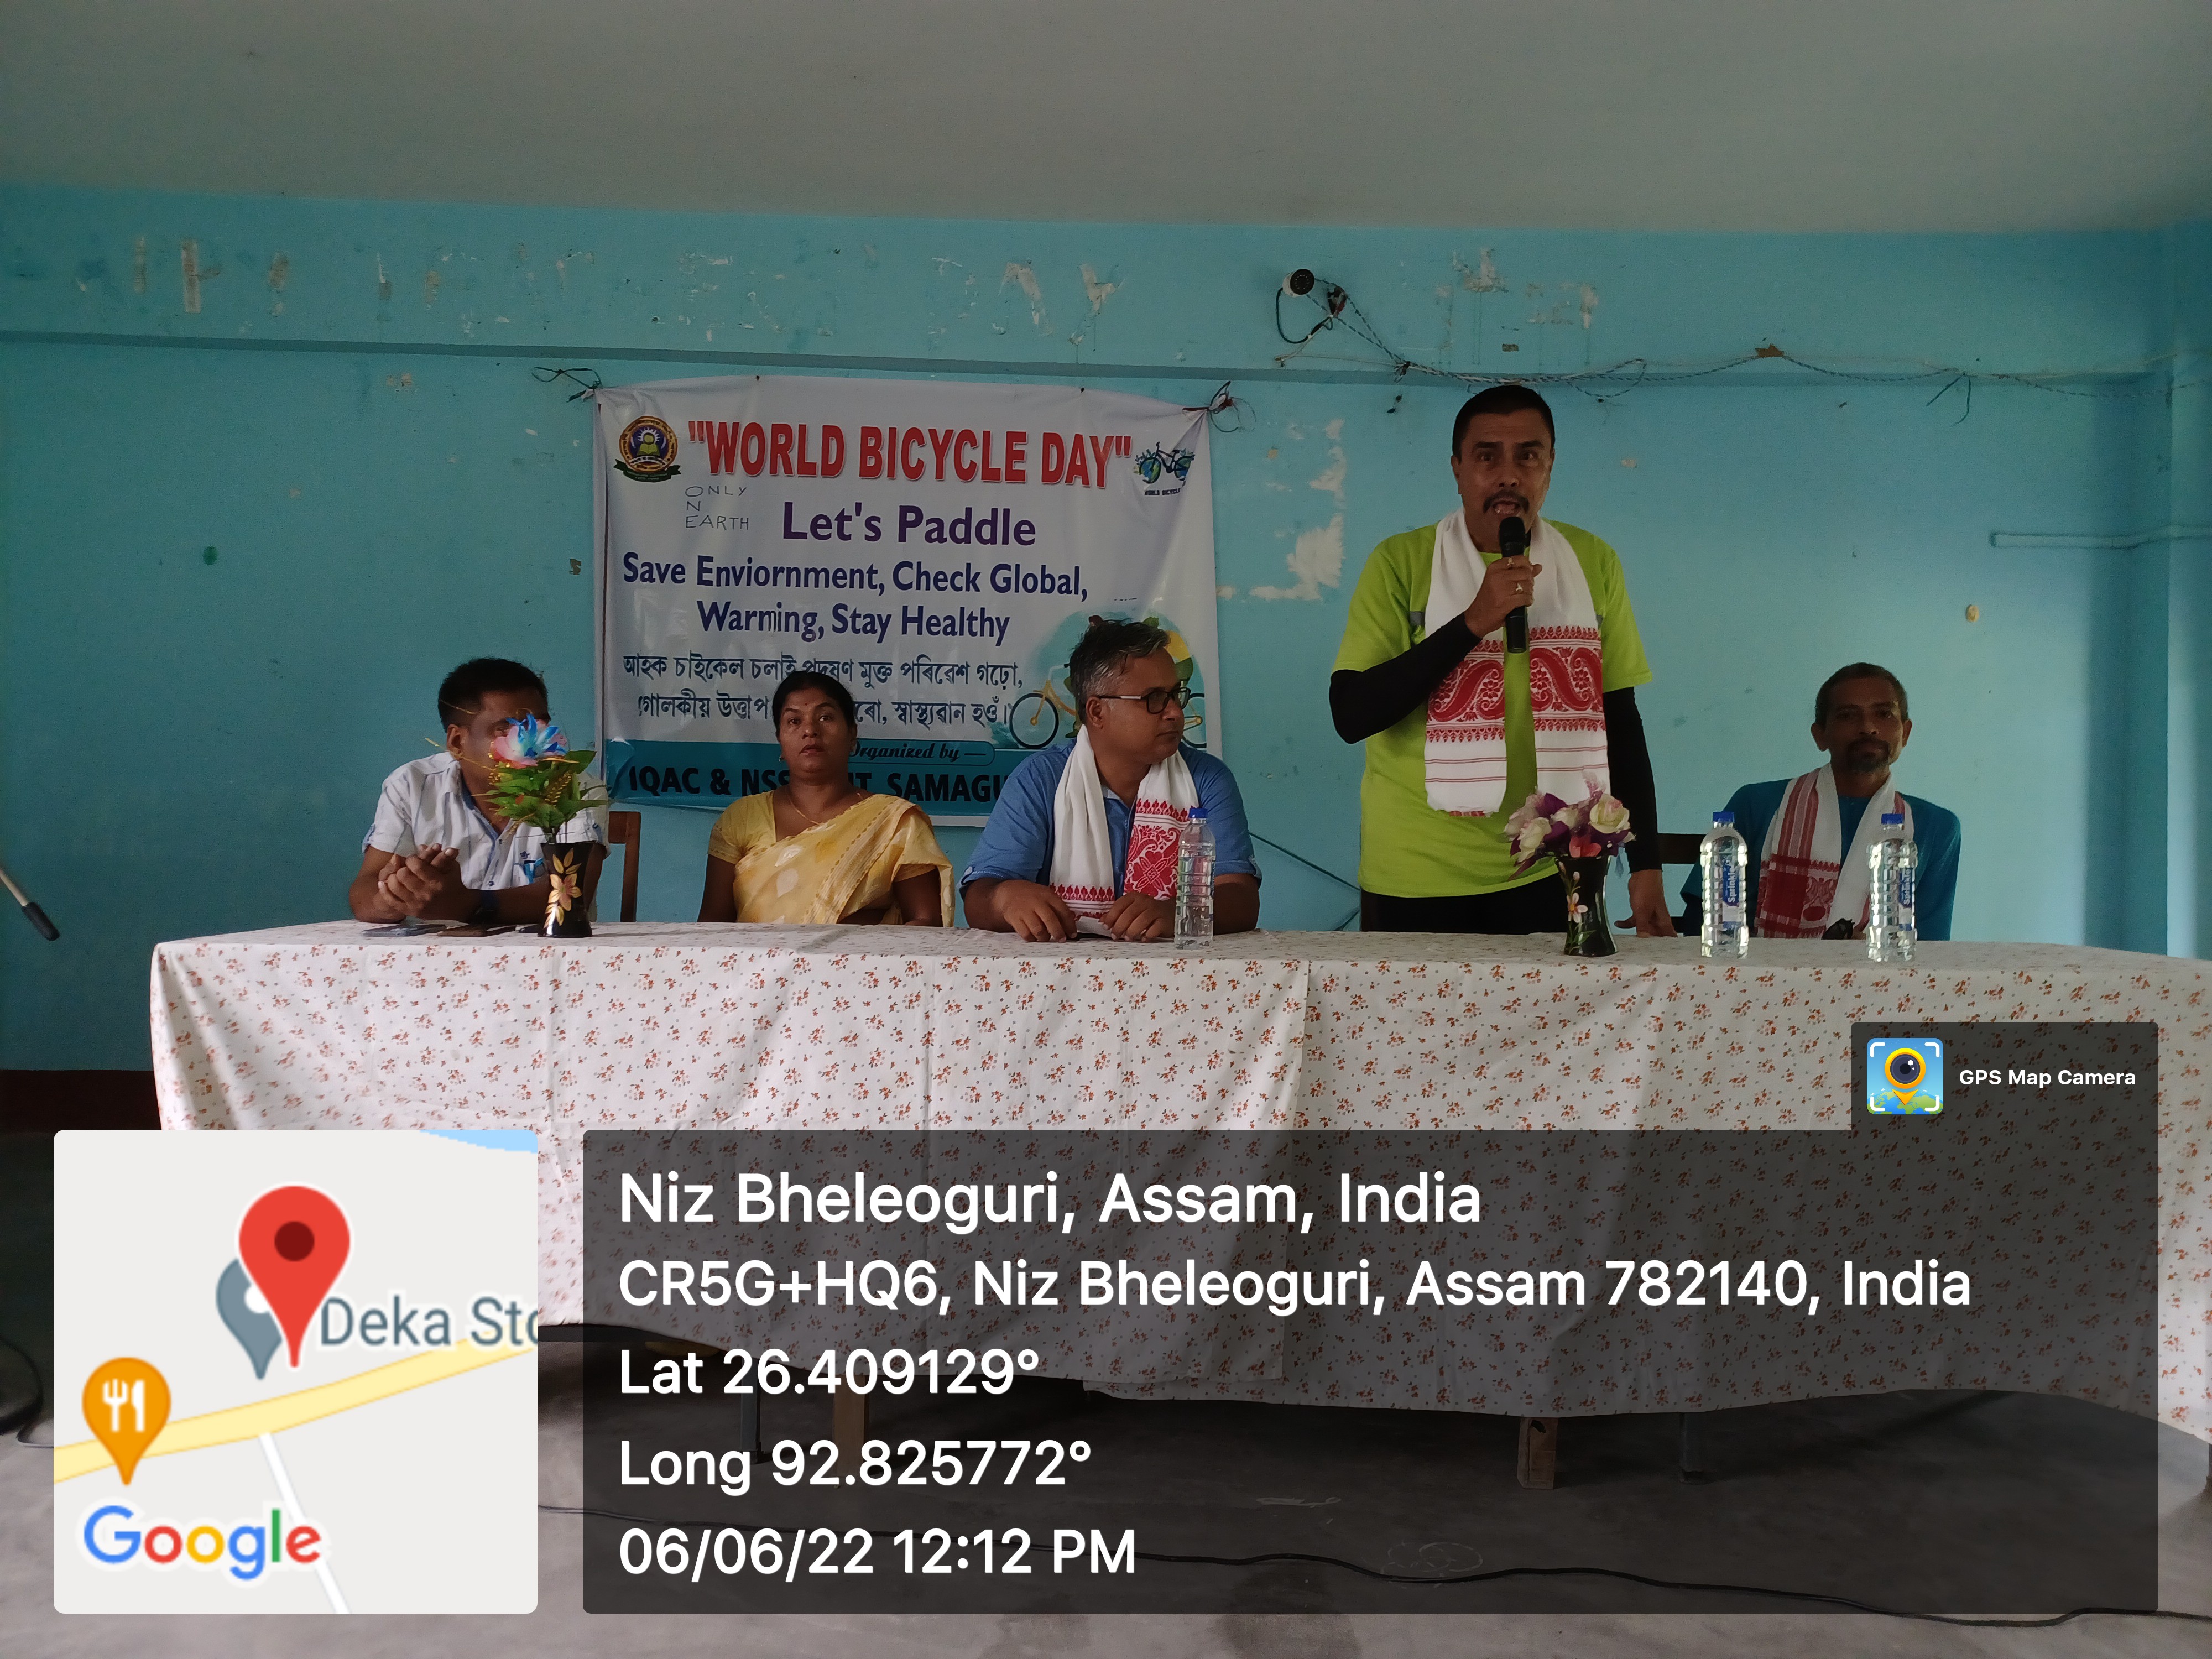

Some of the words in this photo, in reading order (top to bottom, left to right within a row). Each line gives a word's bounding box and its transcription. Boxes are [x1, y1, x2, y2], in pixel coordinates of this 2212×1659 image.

[688, 420, 844, 477] "WORLD
[859, 426, 1027, 483] BICYCLE
[1041, 432, 1131, 488] DAY"
[685, 485, 747, 497] ONLY
[686, 515, 749, 530] EARTH
[783, 502, 881, 541] Let's
[898, 505, 1036, 546] Paddle
[623, 552, 686, 585] Save
[697, 555, 885, 597] Enviornment,
[893, 561, 981, 593] Check
[990, 564, 1088, 602] Global,
[696, 600, 825, 643] Warming,
[832, 604, 892, 643] Stay
[901, 607, 1010, 646] Healthy
[939, 743, 960, 762] by
[629, 766, 701, 797] IQAC
[710, 768, 732, 796] &
